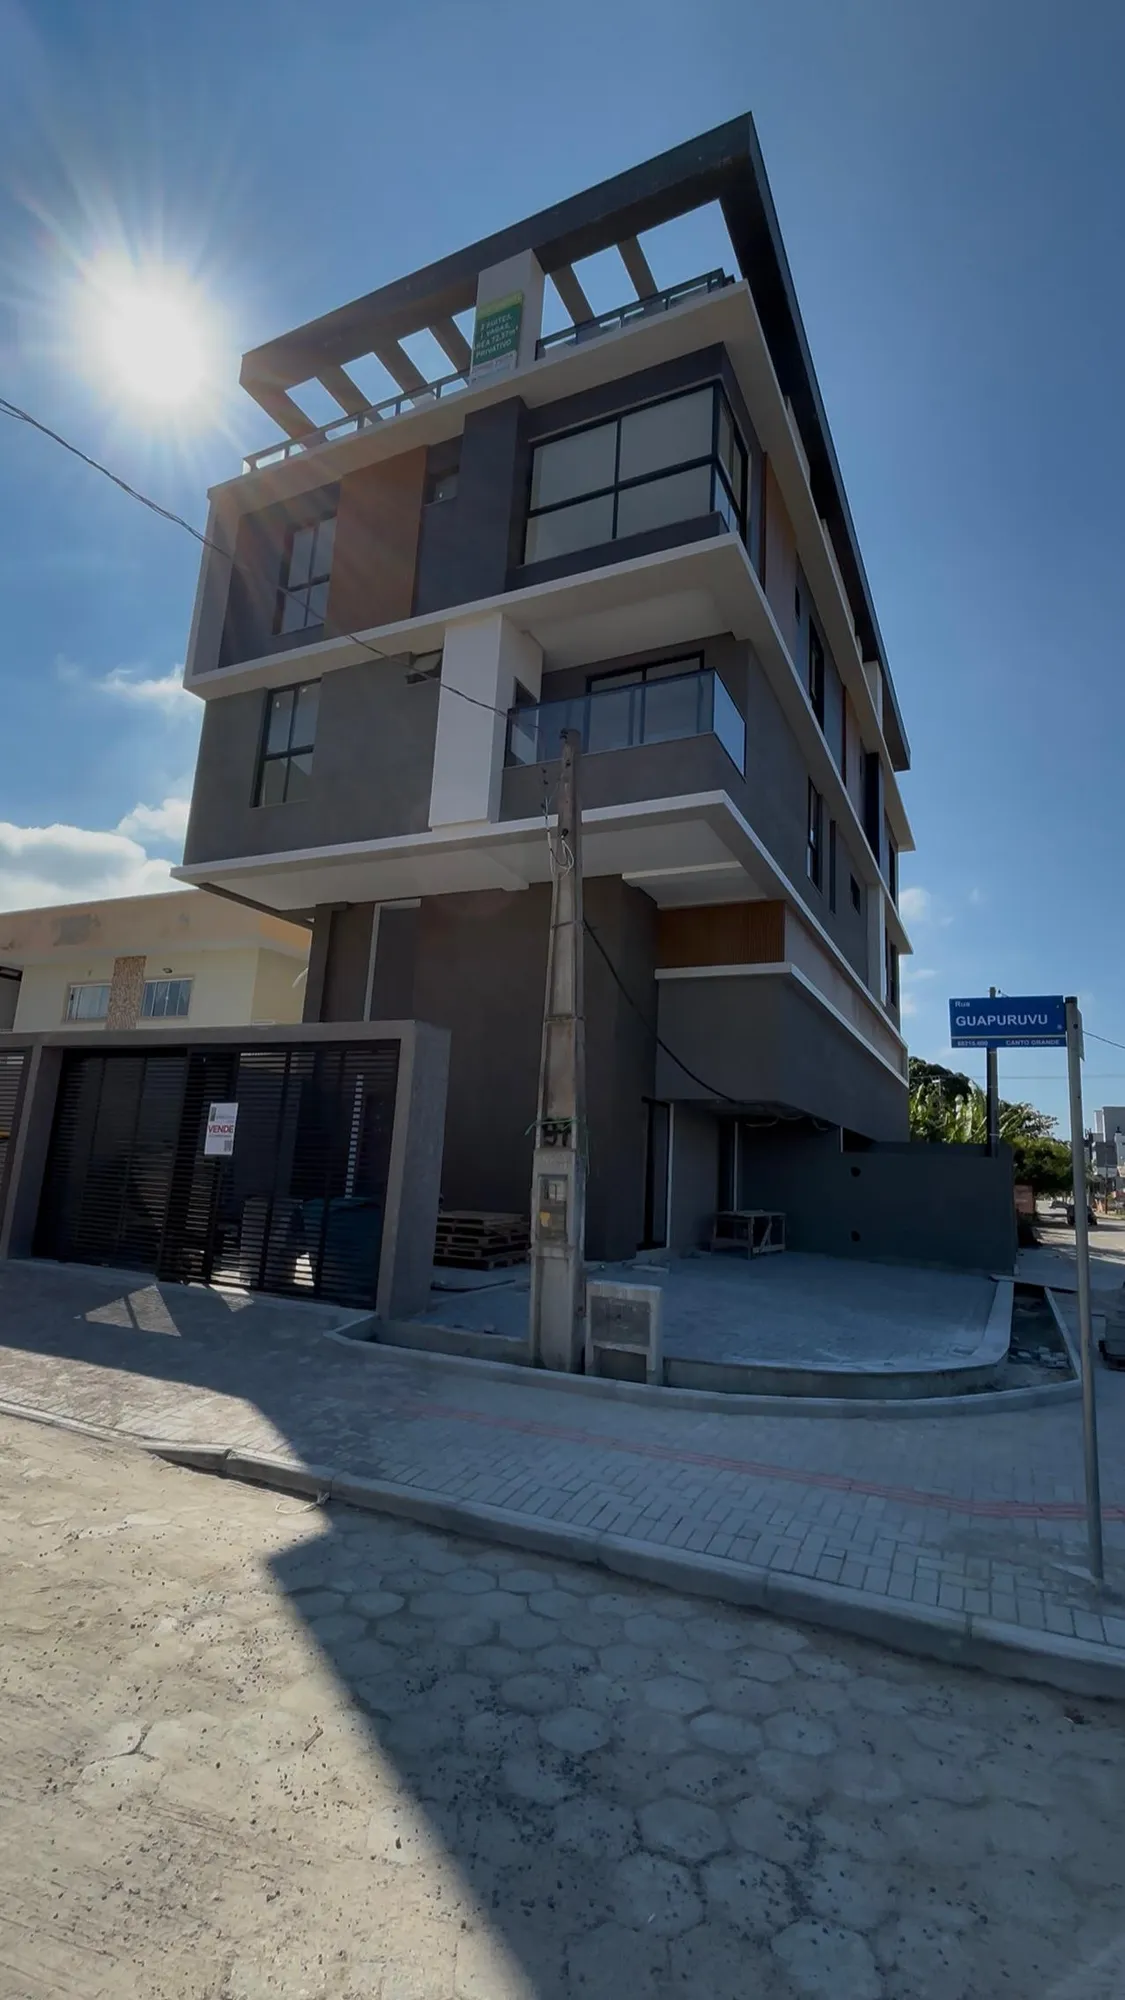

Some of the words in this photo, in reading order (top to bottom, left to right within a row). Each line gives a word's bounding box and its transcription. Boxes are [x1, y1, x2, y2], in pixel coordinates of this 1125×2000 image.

[476, 339, 512, 358] PRIVATIVO
[956, 1014, 1048, 1026] GUAPURUVU
[208, 1124, 234, 1133] VENDE
